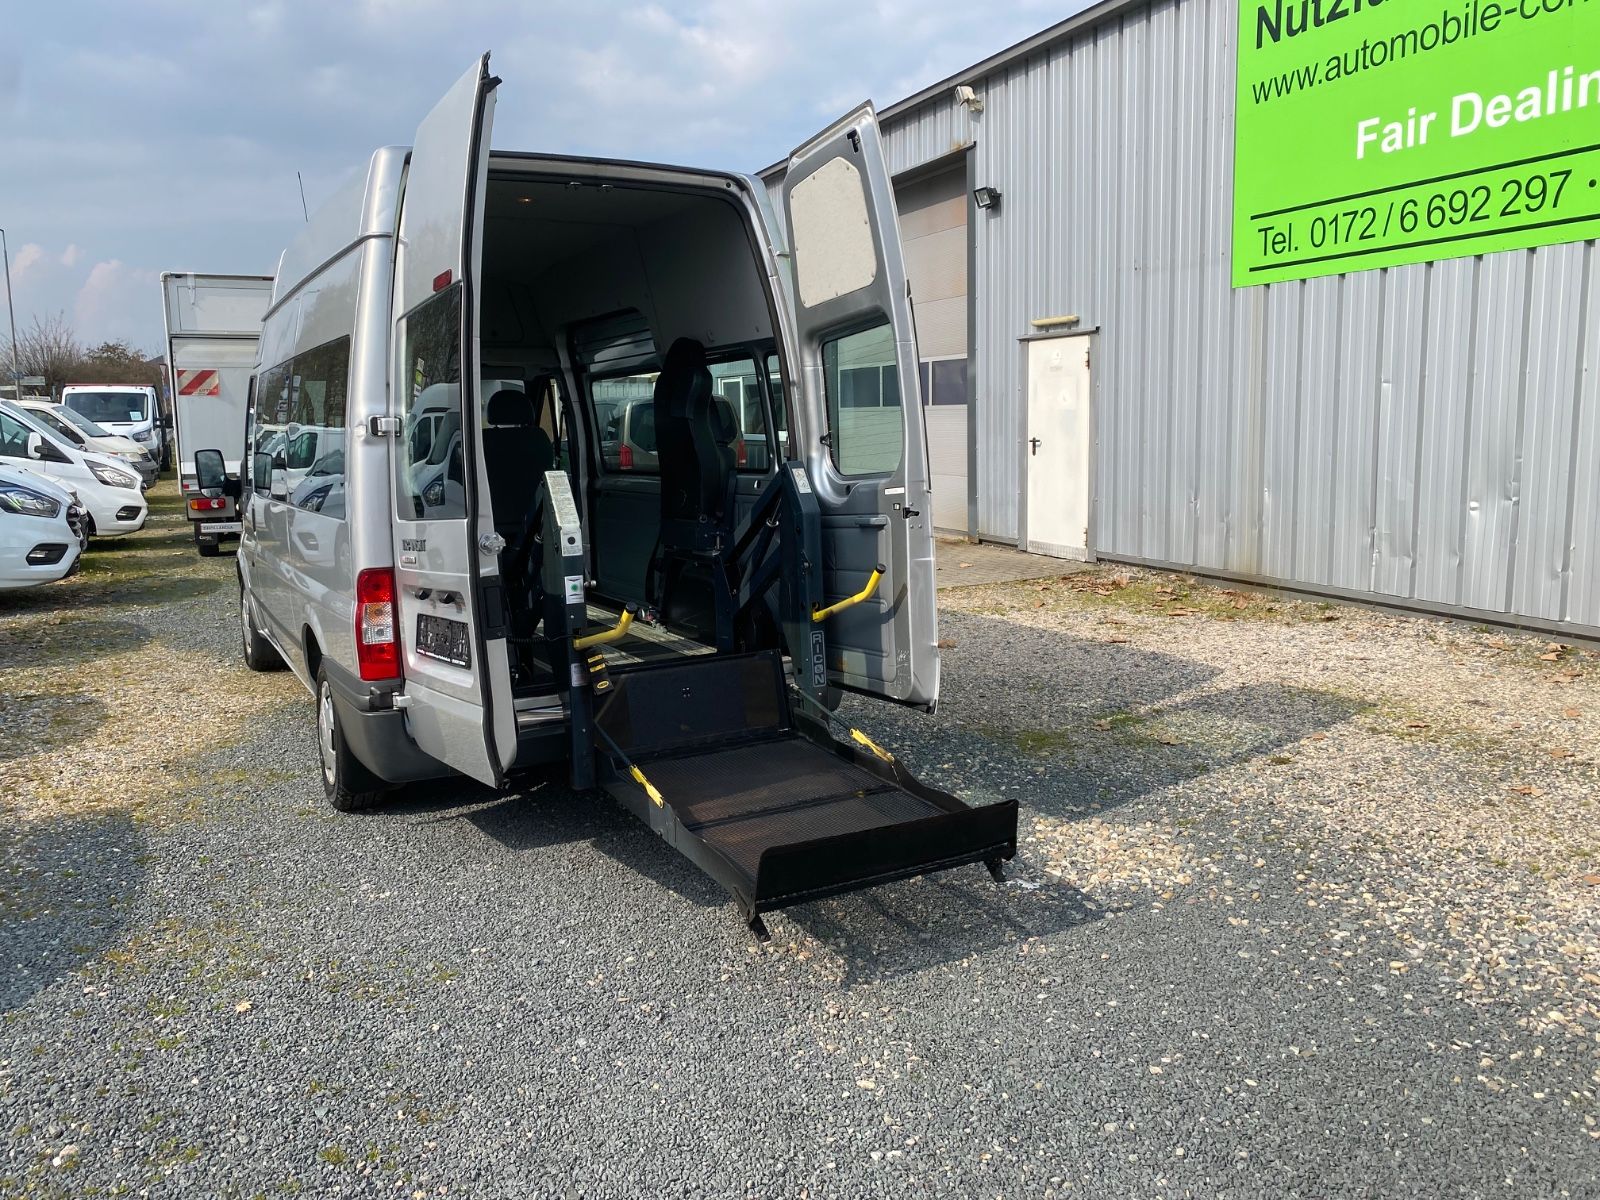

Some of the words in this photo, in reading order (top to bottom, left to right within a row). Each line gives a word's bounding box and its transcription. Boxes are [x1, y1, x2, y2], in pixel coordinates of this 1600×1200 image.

[1356, 107, 1438, 160] Fair
[1257, 222, 1299, 257] Tel.
[812, 633, 825, 685] RICON
